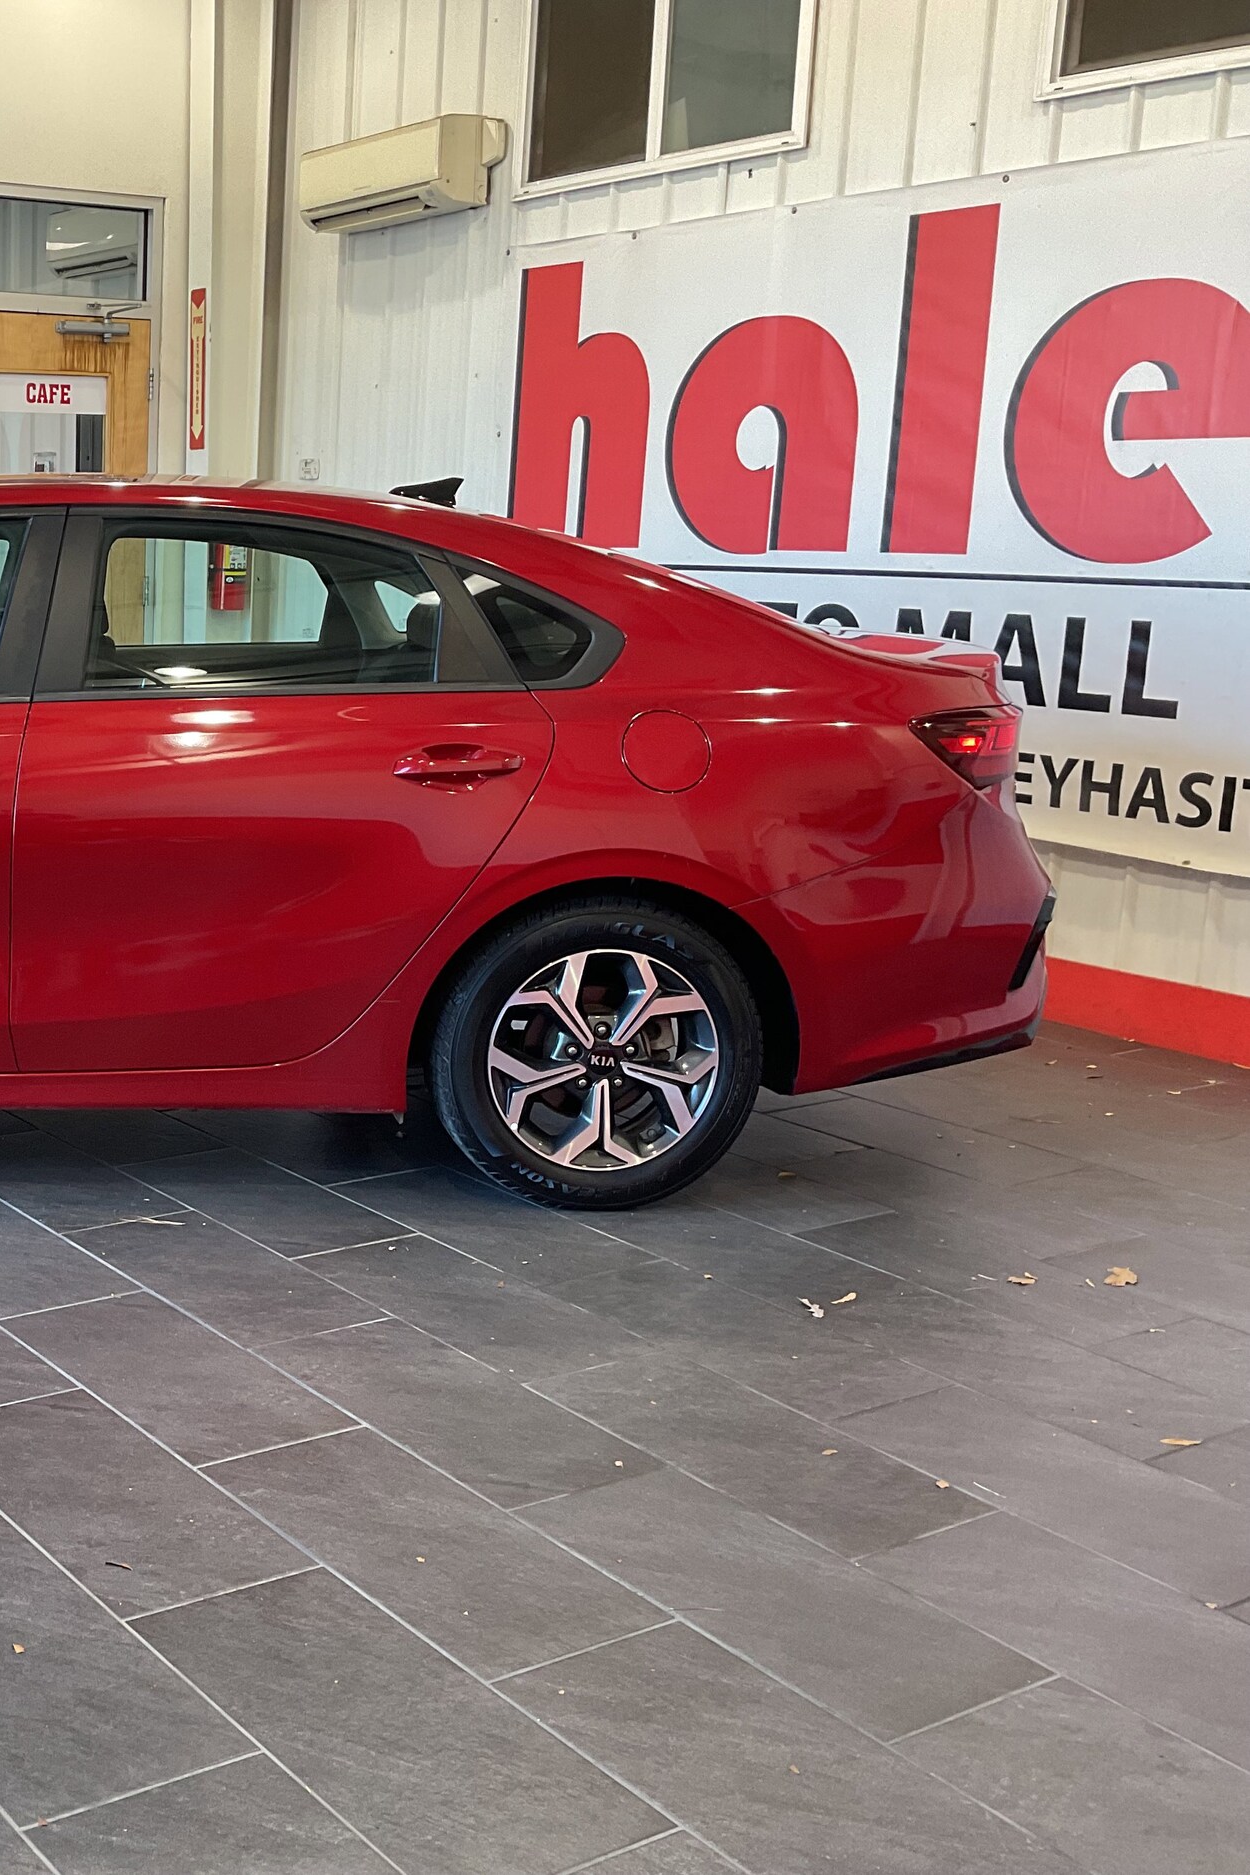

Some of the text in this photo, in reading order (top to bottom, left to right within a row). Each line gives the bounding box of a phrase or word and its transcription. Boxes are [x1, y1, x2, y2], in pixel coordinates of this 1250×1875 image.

[193, 316, 203, 324] FIRE
[26, 382, 71, 405] CAFE
[896, 608, 1178, 719] ALL
[1014, 752, 1250, 832] EYHASI
[591, 1054, 615, 1067] KIA
